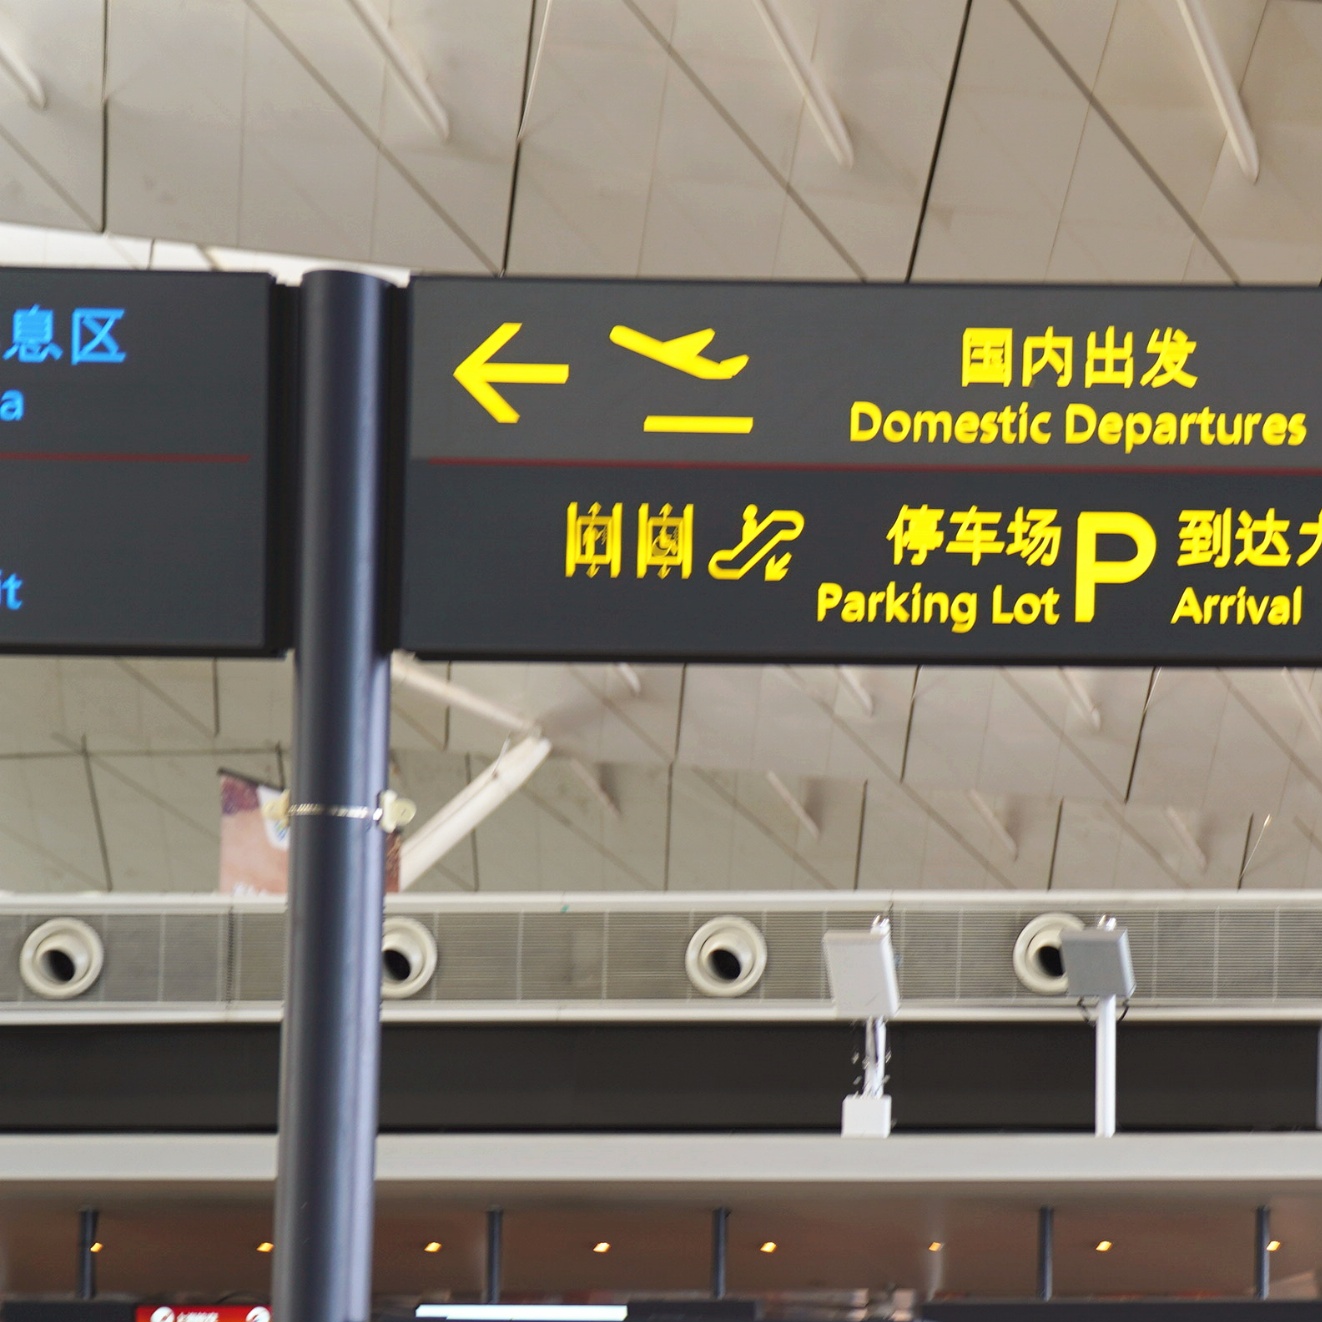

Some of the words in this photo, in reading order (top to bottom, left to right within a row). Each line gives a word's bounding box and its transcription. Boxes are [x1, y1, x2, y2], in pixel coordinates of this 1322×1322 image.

[3, 304, 127, 365] 息区
[961, 326, 1198, 389] 国内出发
[849, 402, 1052, 446] Domestic
[1064, 404, 1307, 454] Departures
[886, 505, 1063, 567] 停车场
[1074, 511, 1157, 623] P
[817, 583, 975, 634] Parking
[991, 586, 1060, 627] Lot
[1171, 586, 1302, 627] Arrival
